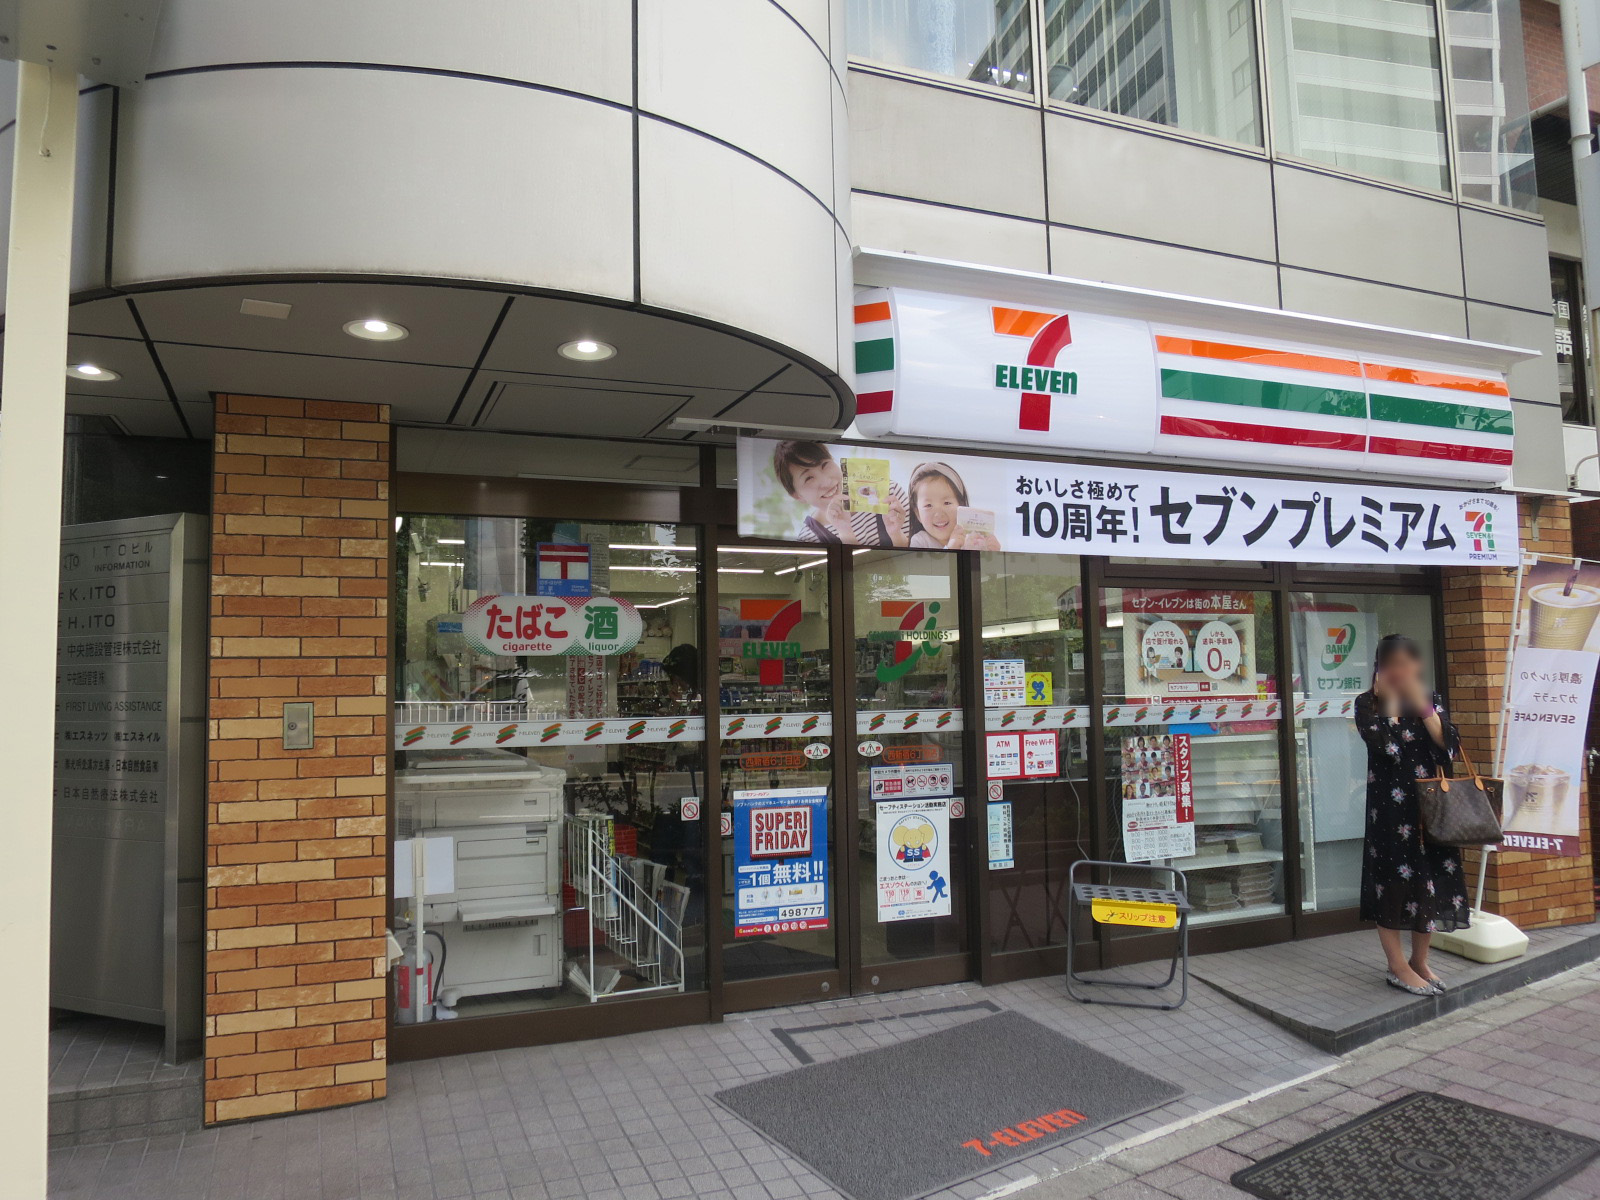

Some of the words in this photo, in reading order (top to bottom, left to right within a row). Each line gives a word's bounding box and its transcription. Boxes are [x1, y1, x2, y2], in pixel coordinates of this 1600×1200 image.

[1015, 474, 1138, 504] おいしさ極めて
[1015, 501, 1140, 544] 10周年!
[1149, 484, 1456, 552] セブンプレミアム
[95, 560, 150, 572] INFORMATION
[485, 603, 569, 640] たばこ
[584, 605, 619, 640] 酒
[906, 631, 948, 641] HOLDINGS
[1145, 637, 1184, 646] 店で受け取れる
[67, 640, 162, 658] 中央施設管理株式会社
[502, 642, 552, 653] cigarette
[588, 641, 620, 653] liquor
[1325, 644, 1350, 655] BANK
[1207, 647, 1222, 672] 0
[1223, 660, 1231, 670] 円
[1317, 677, 1361, 690] セブン銀行
[65, 702, 87, 712] FIRST
[88, 701, 112, 712] LIVING
[114, 701, 162, 712] ASSISTANCE
[996, 740, 1010, 748] ATM
[1025, 739, 1037, 747] Free
[1039, 738, 1054, 747] Wi-Fi
[745, 756, 801, 767] 西新宿6丁目店
[1178, 735, 1192, 820] スタッフ募集!
[63, 787, 159, 803] 日本自然療法株式会社
[755, 811, 807, 832] SUPER!
[755, 830, 808, 851] FRIDAY
[906, 848, 921, 856] SS
[780, 906, 823, 918] 498777
[1119, 912, 1167, 923] スリップ注意
